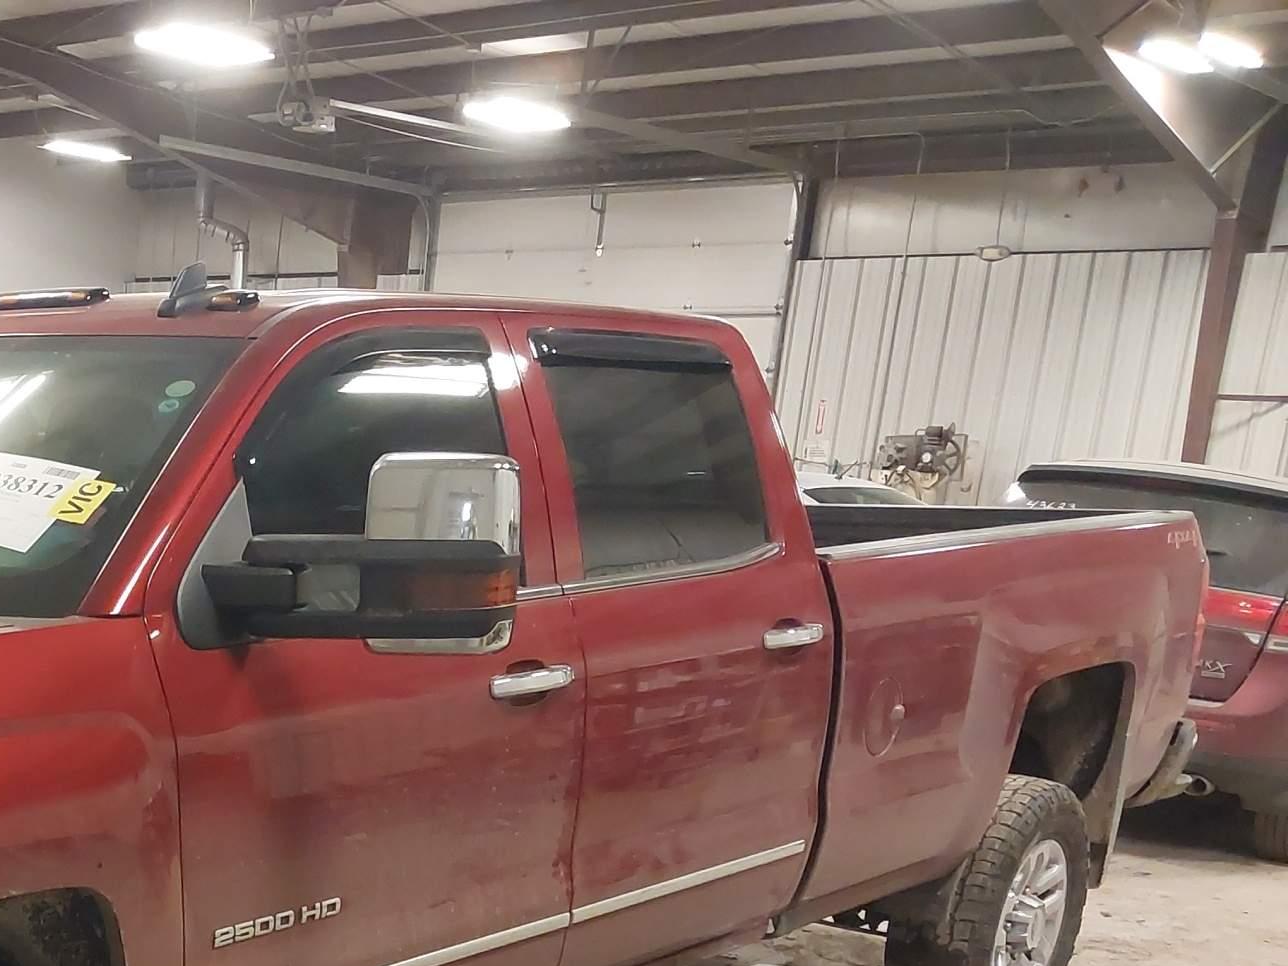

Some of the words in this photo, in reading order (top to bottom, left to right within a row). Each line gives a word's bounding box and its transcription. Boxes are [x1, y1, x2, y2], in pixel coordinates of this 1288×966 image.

[58, 482, 103, 516] VIC
[214, 910, 294, 949] 2500
[301, 896, 341, 924] HD
